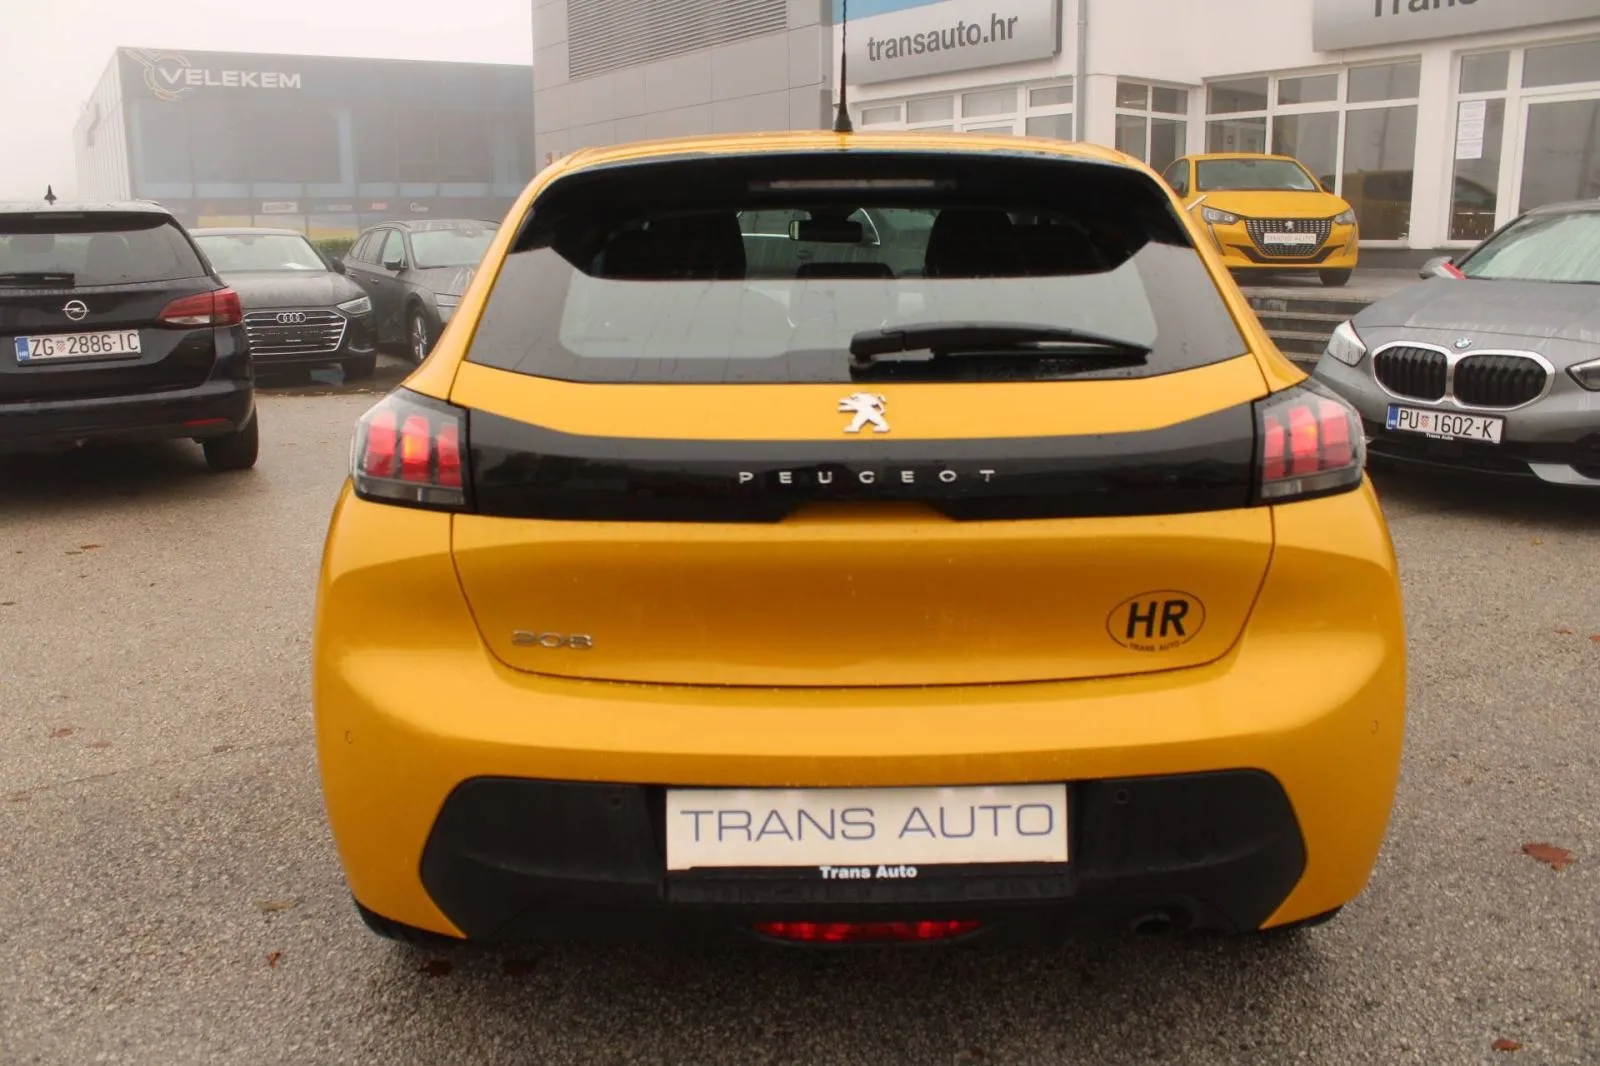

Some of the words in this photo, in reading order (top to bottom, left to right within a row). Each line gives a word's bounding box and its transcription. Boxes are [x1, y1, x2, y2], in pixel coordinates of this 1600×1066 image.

[867, 13, 1018, 62] transauto.hr
[158, 68, 302, 89] VELEKEM
[30, 338, 54, 357] ZG
[1399, 409, 1420, 429] PU
[1434, 414, 1494, 439] 1602-K
[738, 469, 996, 485] PEUGEOT
[1126, 599, 1189, 639] HR
[512, 630, 592, 650] 208
[1129, 641, 1156, 653] TRANS
[1159, 639, 1181, 651] AUTO
[680, 808, 876, 842] TRANS
[898, 803, 1054, 839] AUTO
[819, 866, 871, 879] Trans
[876, 865, 918, 879] Auto
